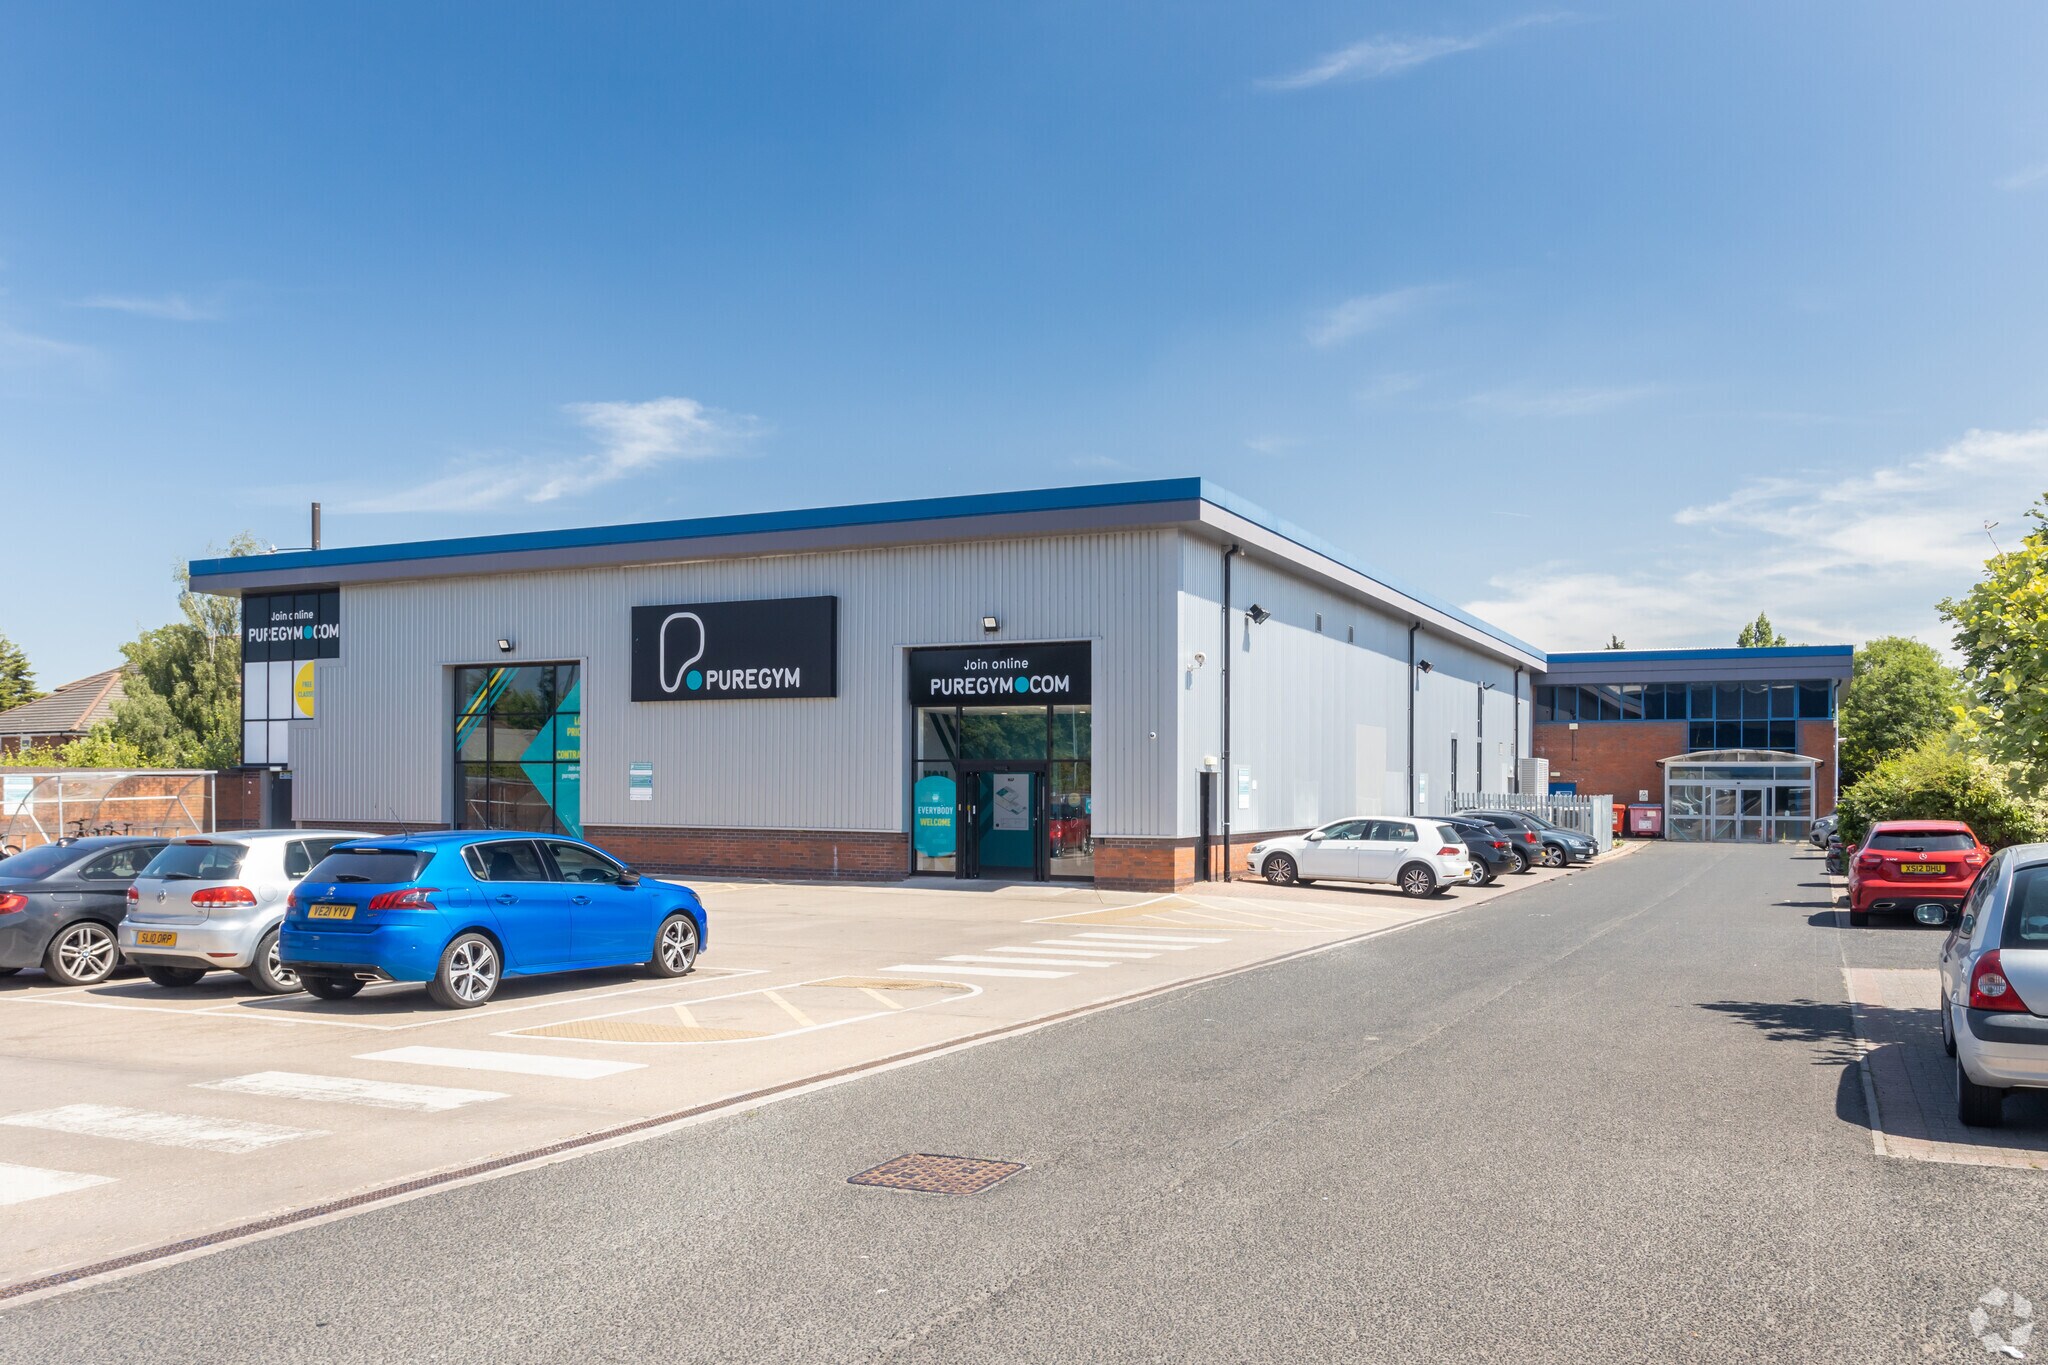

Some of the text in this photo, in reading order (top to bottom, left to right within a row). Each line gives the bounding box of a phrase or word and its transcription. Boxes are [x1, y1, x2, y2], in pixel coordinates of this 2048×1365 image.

[271, 611, 287, 621] Join
[964, 657, 1029, 671] Join online
[706, 667, 801, 691] PUREGYM
[918, 806, 954, 815] EVERYBODY
[920, 818, 951, 827] WELCOME
[314, 906, 351, 918] VE21 YYU
